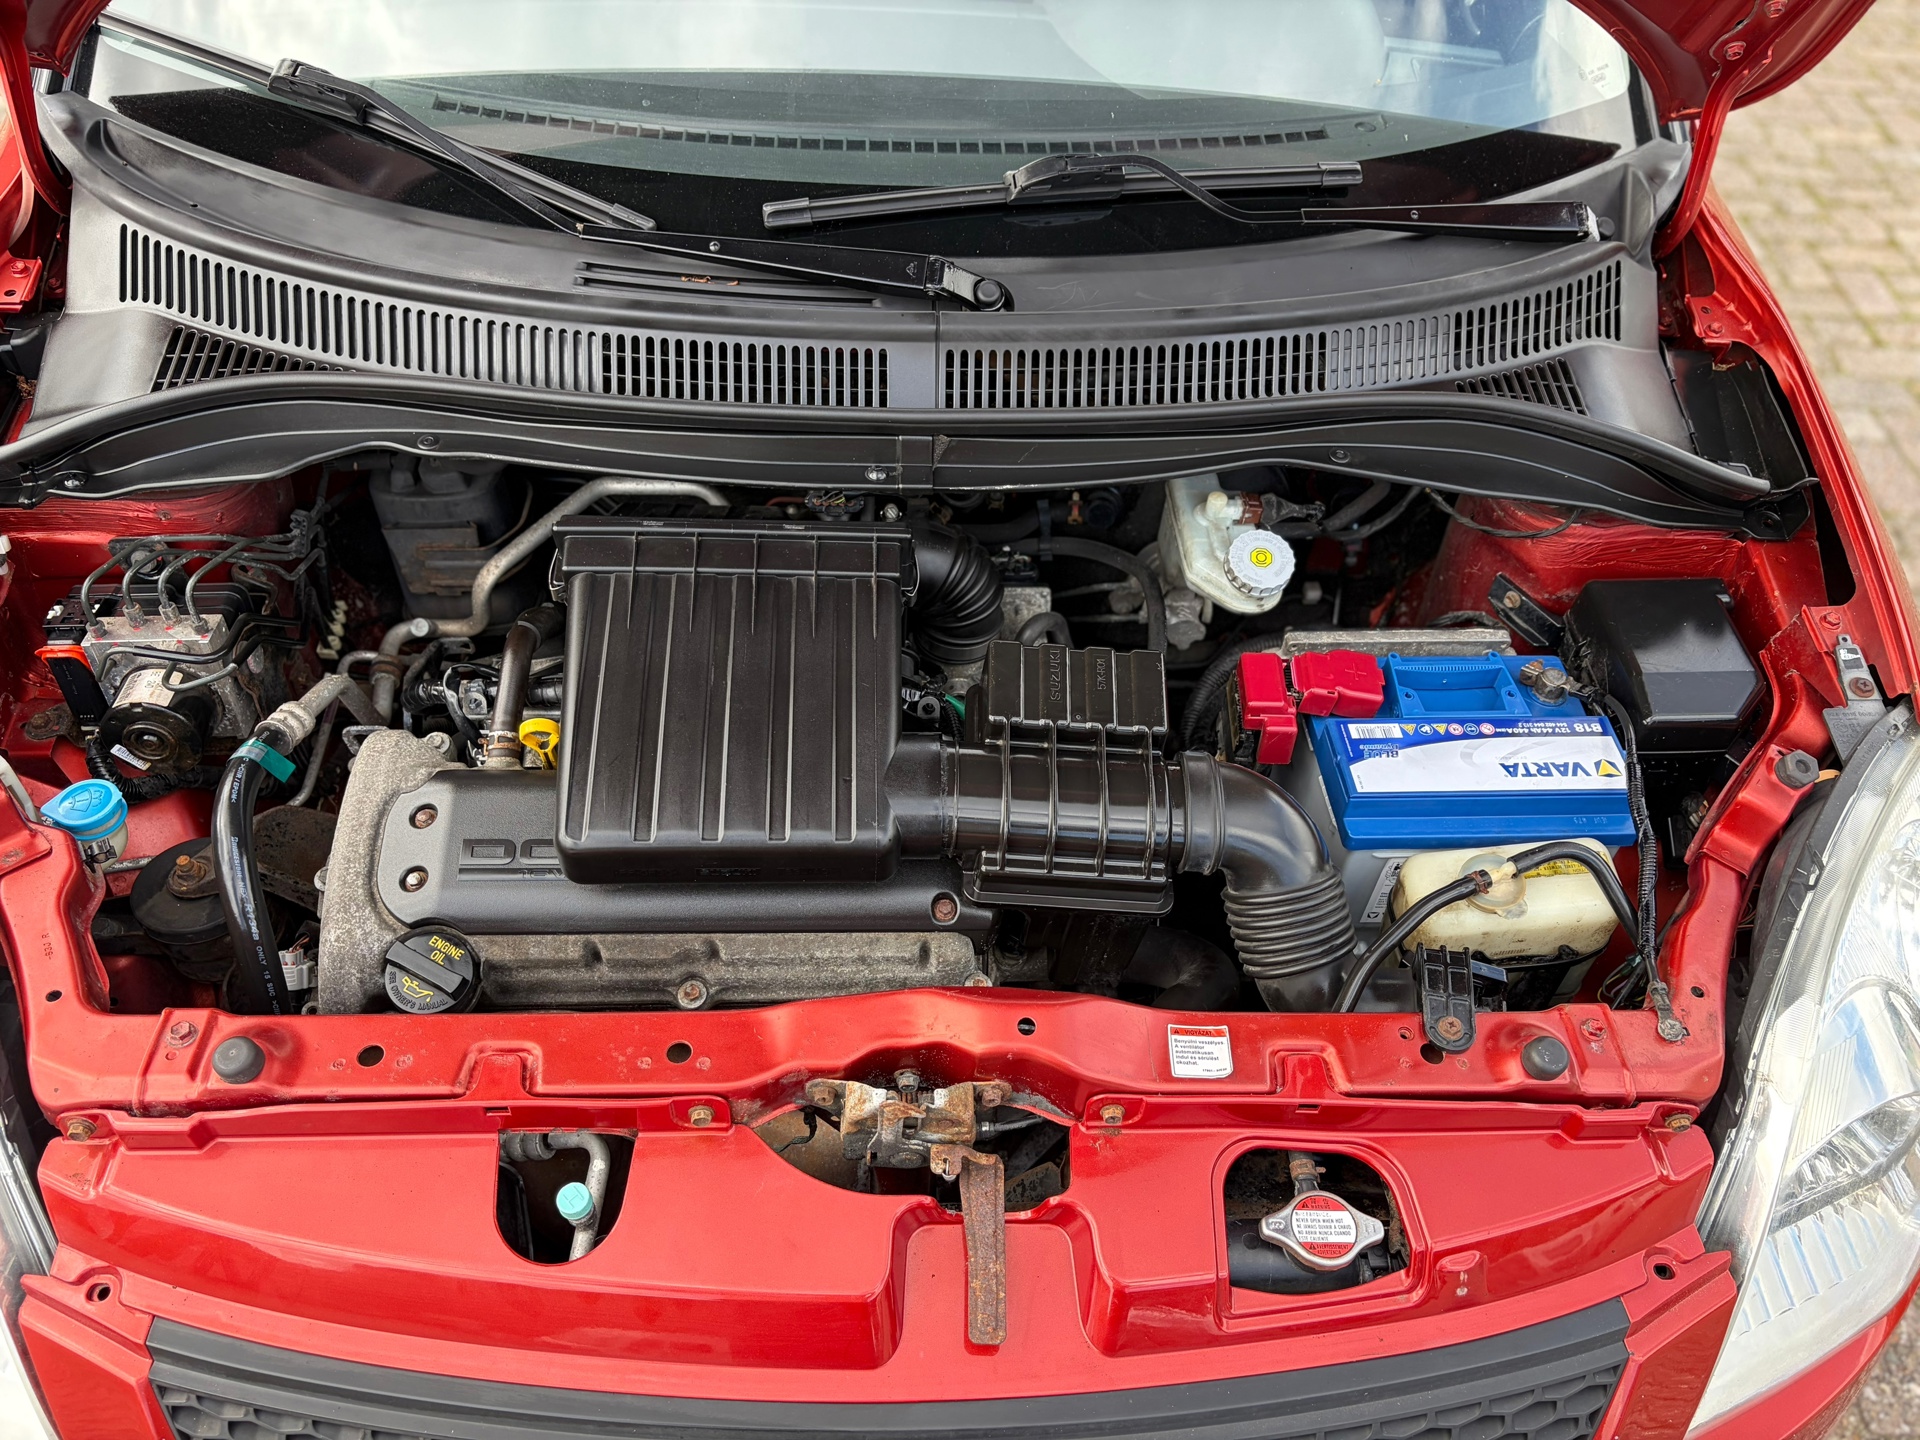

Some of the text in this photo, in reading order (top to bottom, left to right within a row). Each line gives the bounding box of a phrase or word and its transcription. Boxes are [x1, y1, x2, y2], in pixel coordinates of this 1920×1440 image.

[1049, 648, 1062, 702] SUZUKI
[1573, 722, 1603, 733] B18
[1363, 750, 1400, 760] BLUE
[1498, 762, 1593, 778] VARTA
[428, 935, 466, 960] ENGINE
[430, 949, 446, 966] OIL
[255, 945, 268, 966] ONLY
[266, 982, 276, 997] SUC
[390, 984, 417, 1010] OWNER'S
[417, 998, 449, 1011] MANUAL
